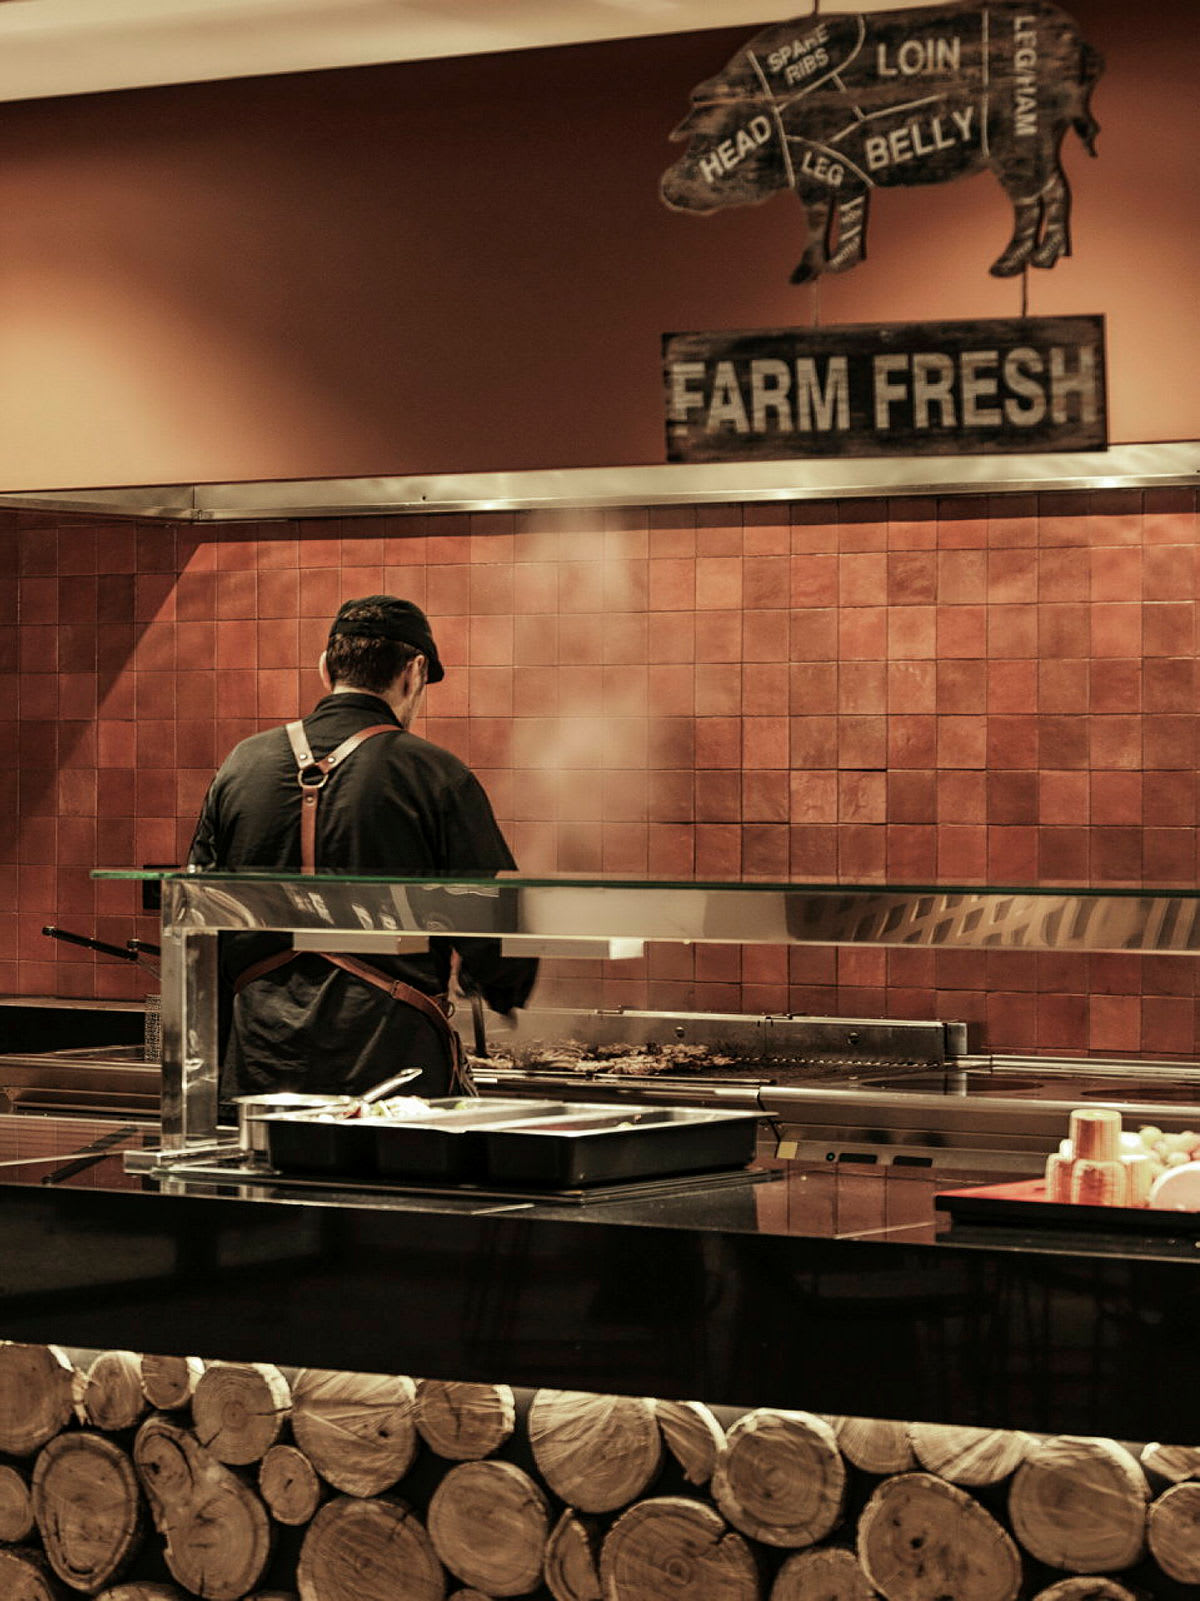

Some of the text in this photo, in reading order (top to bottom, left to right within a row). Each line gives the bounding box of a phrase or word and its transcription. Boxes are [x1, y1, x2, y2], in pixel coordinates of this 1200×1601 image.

[784, 47, 829, 86] RIBS
[877, 37, 961, 77] LOIN
[1013, 15, 1038, 136] LEG/HAM
[699, 114, 773, 184] HEAD
[801, 151, 845, 187] LEG
[864, 105, 976, 171] BELLY
[671, 346, 1101, 436] FARM FRESH
